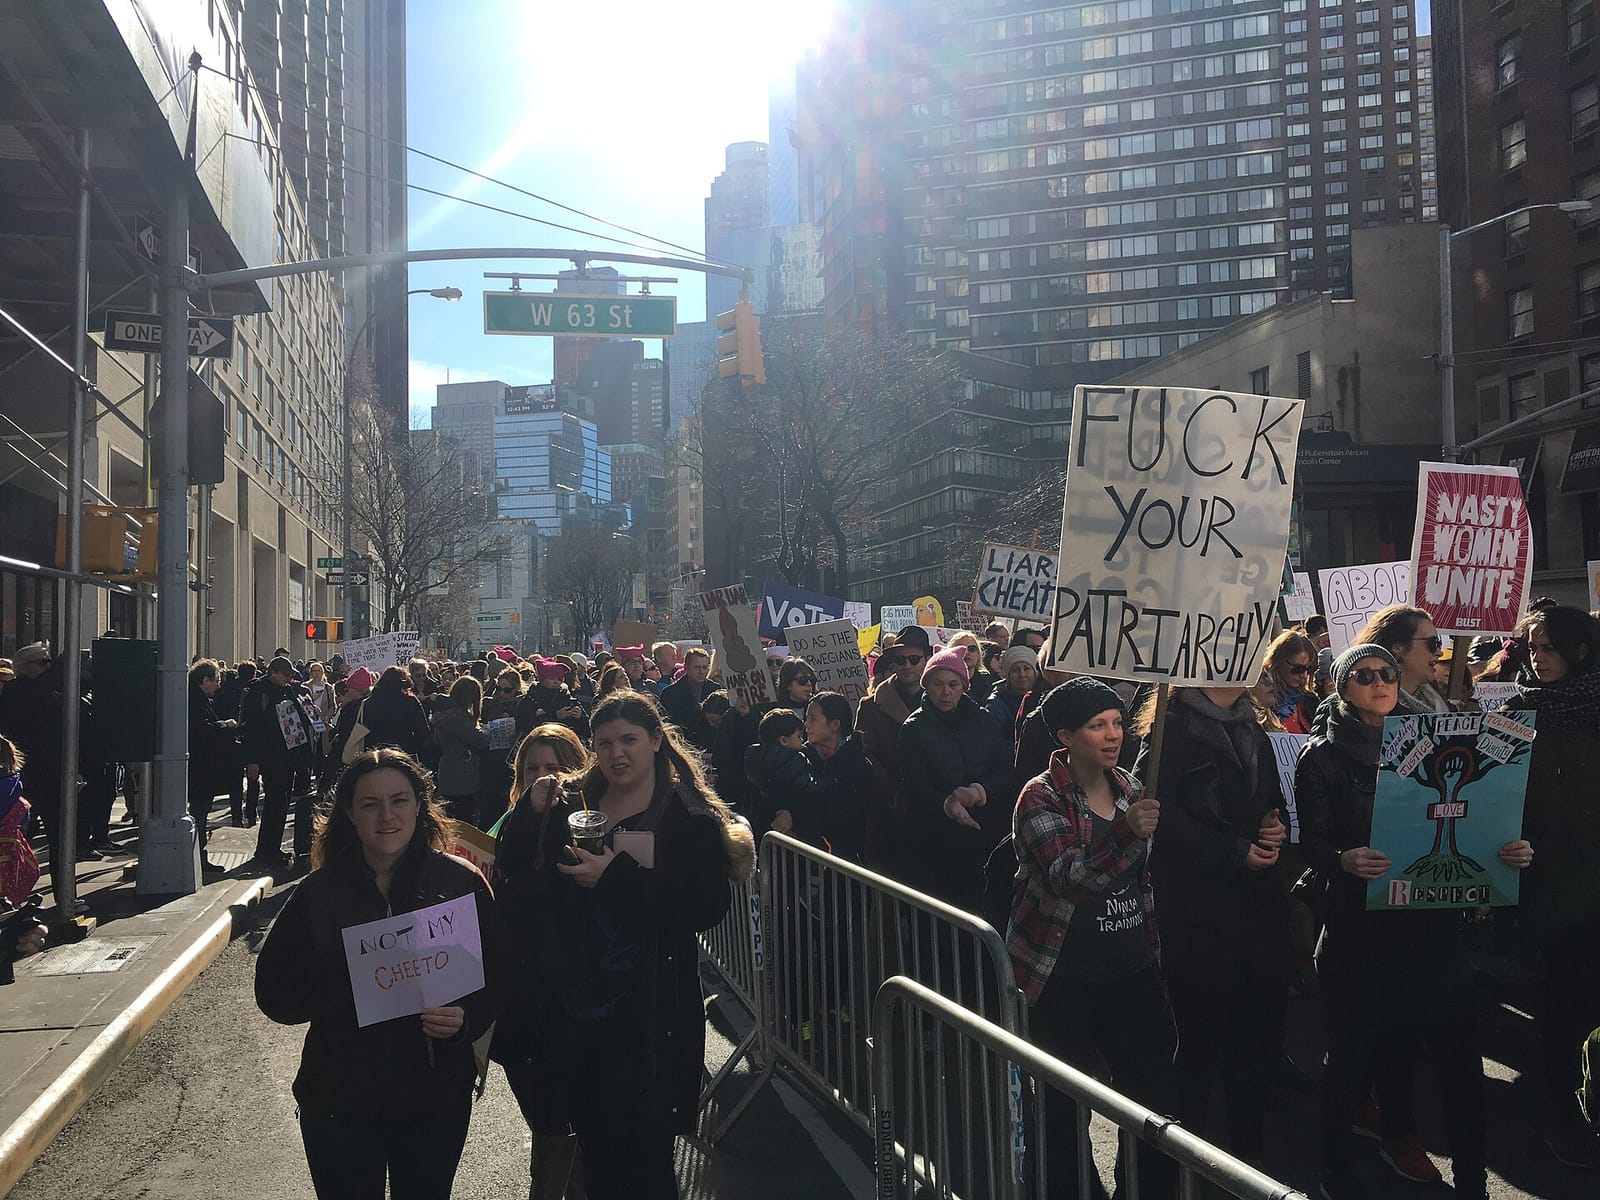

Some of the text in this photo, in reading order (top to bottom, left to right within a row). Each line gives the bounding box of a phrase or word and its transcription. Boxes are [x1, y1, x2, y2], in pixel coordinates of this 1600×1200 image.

[530, 303, 632, 328] W 63 St
[191, 330, 213, 346] AY
[1076, 387, 1298, 486] FUCK
[1319, 457, 1342, 465] Center
[1345, 449, 1369, 457] Atrium
[1436, 491, 1522, 528] NASTY
[1103, 486, 1242, 562] YOUR
[1433, 524, 1521, 567] WOMEN
[1425, 565, 1516, 609] UNITE
[1046, 587, 1276, 682] PATRIARCHY
[1455, 617, 1481, 629] BUST
[793, 631, 853, 651] DO AS THE
[808, 648, 861, 667] RWEGIANS
[837, 665, 863, 680] MORE
[1438, 718, 1479, 732] PEACE
[1487, 713, 1536, 738] TOLERANCE
[1480, 737, 1511, 761] Dignity
[1435, 804, 1463, 817] LOVE
[360, 912, 454, 956] NOT MY
[751, 897, 763, 968] NYPD
[374, 951, 449, 991] CHEETO
